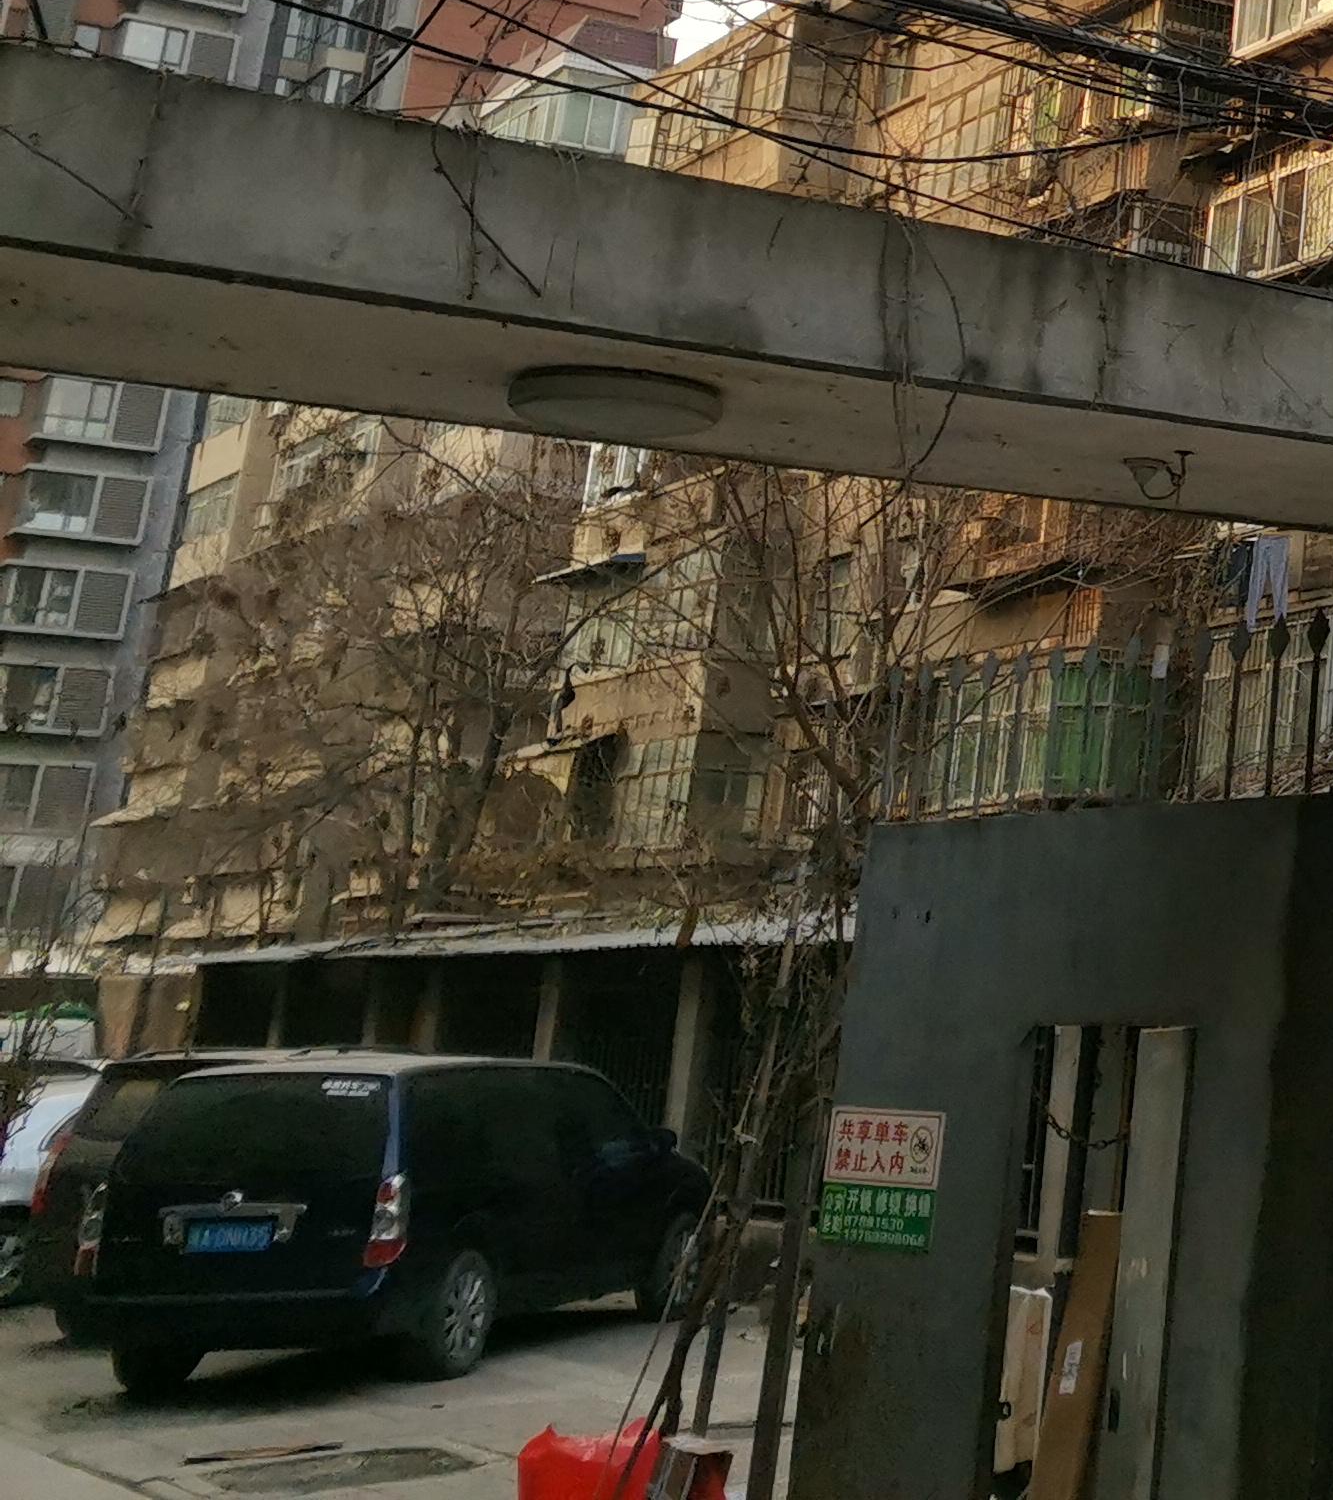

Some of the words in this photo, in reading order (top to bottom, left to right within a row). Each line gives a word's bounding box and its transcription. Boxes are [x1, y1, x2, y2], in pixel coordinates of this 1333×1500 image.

[838, 1119, 910, 1146] 共享单车
[833, 1145, 905, 1176] 禁止入内
